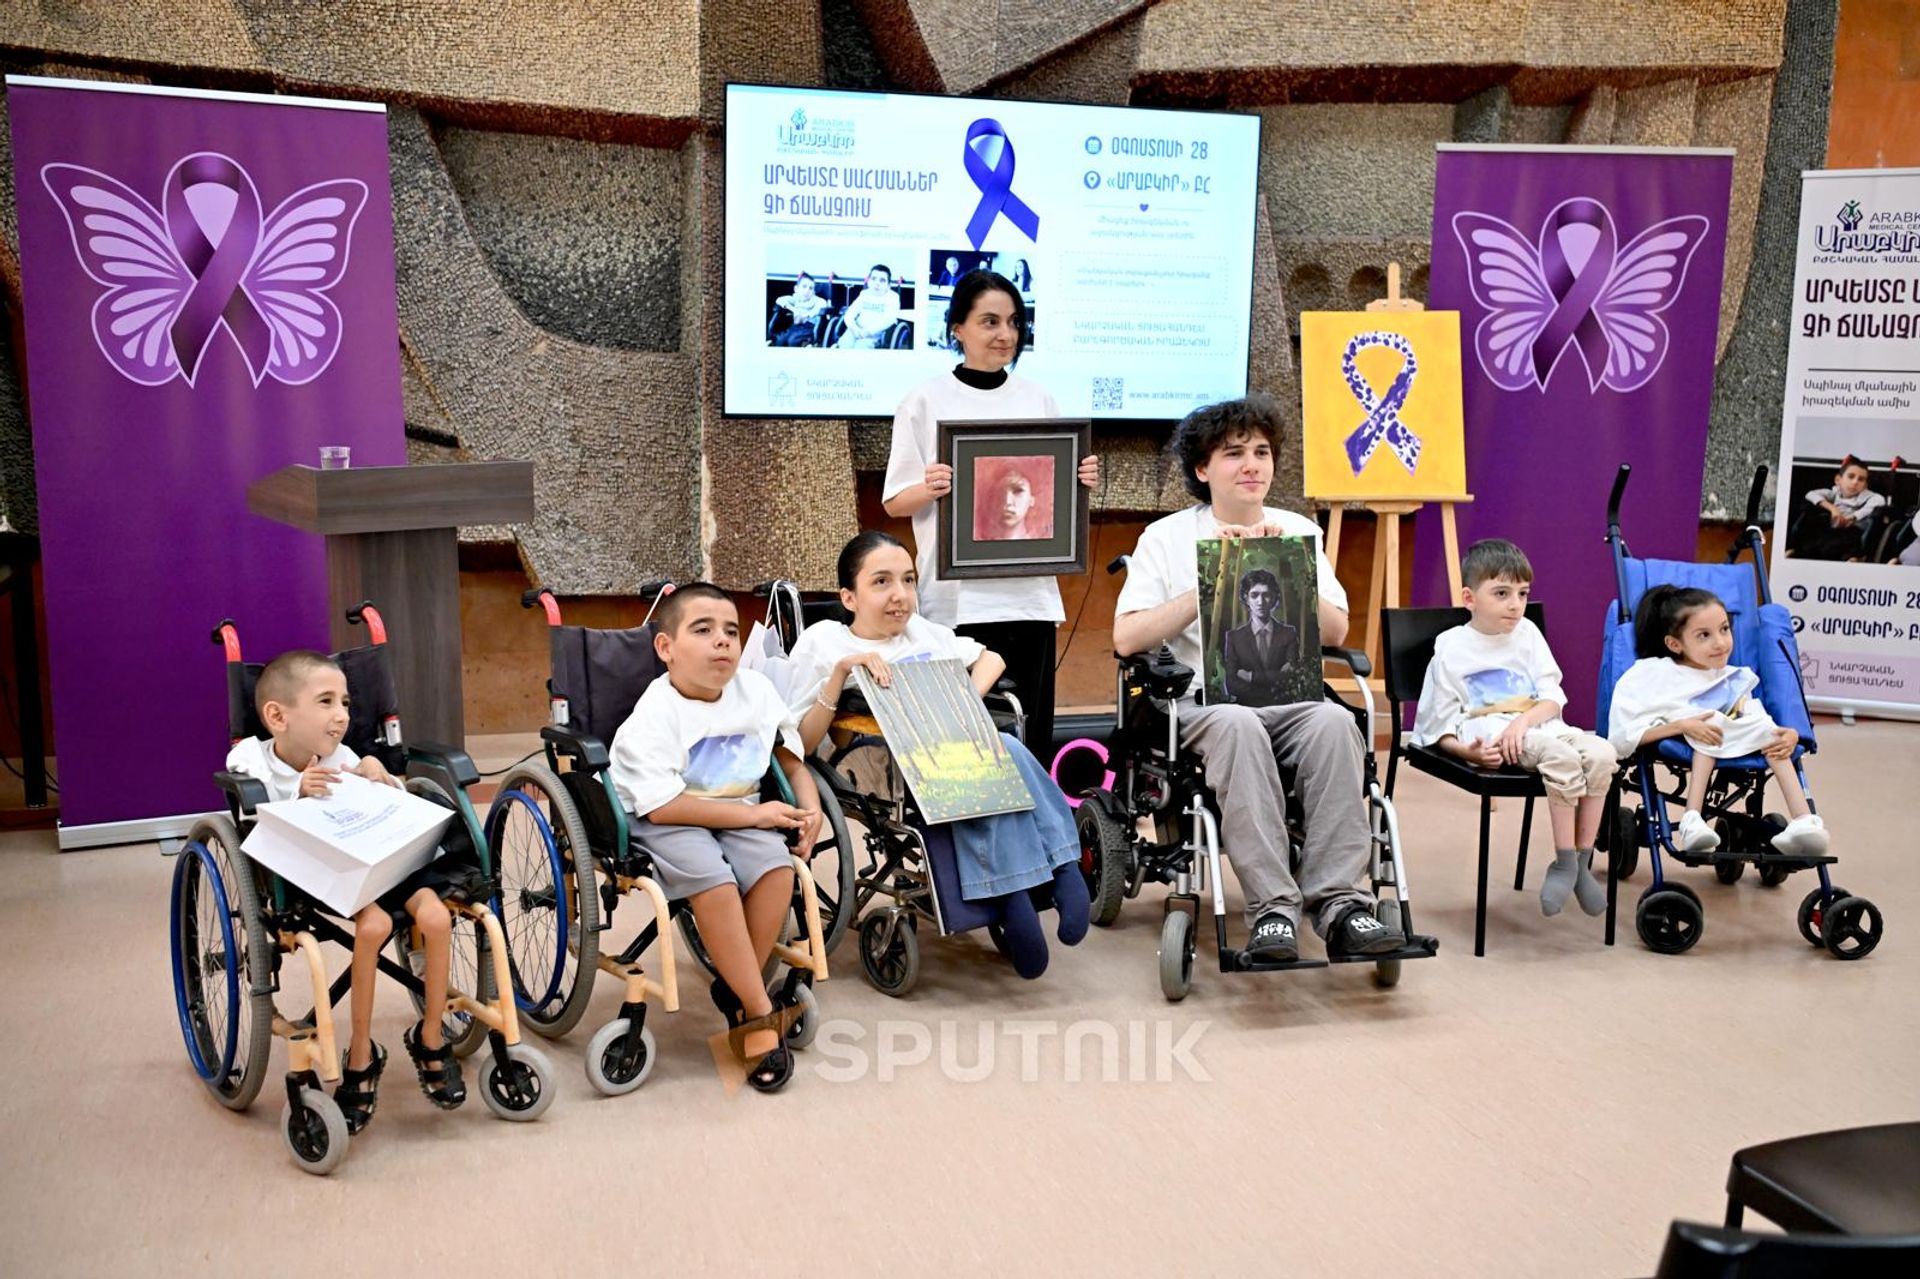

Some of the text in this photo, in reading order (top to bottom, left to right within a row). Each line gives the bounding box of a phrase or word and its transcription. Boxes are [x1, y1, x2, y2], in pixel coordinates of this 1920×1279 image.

[1111, 136, 1209, 160] ՕԳՈՍՏՈՍԻ 28
[764, 163, 939, 192] ԱՐՎԵՍՏԸ ՍԱՀՄԱՆՆԵՐ
[1106, 171, 1190, 192] «ԱՐԱԲԿԻՐ»
[764, 193, 872, 218] ՉԻ ՃԱՆԱՉՈՒՄ
[1805, 278, 1906, 303] ԱՐՎԵՍՏԸ
[1803, 313, 1831, 339] ՉԻ
[1803, 379, 1917, 393] Սպինալ մկանային
[1802, 395, 1911, 409] իրազեկման ամիս
[1817, 585, 1898, 607] ՕԳՈՍՏՈՍԻ
[1811, 617, 1904, 638] «ԱՐԱԲԿԻՐ»
